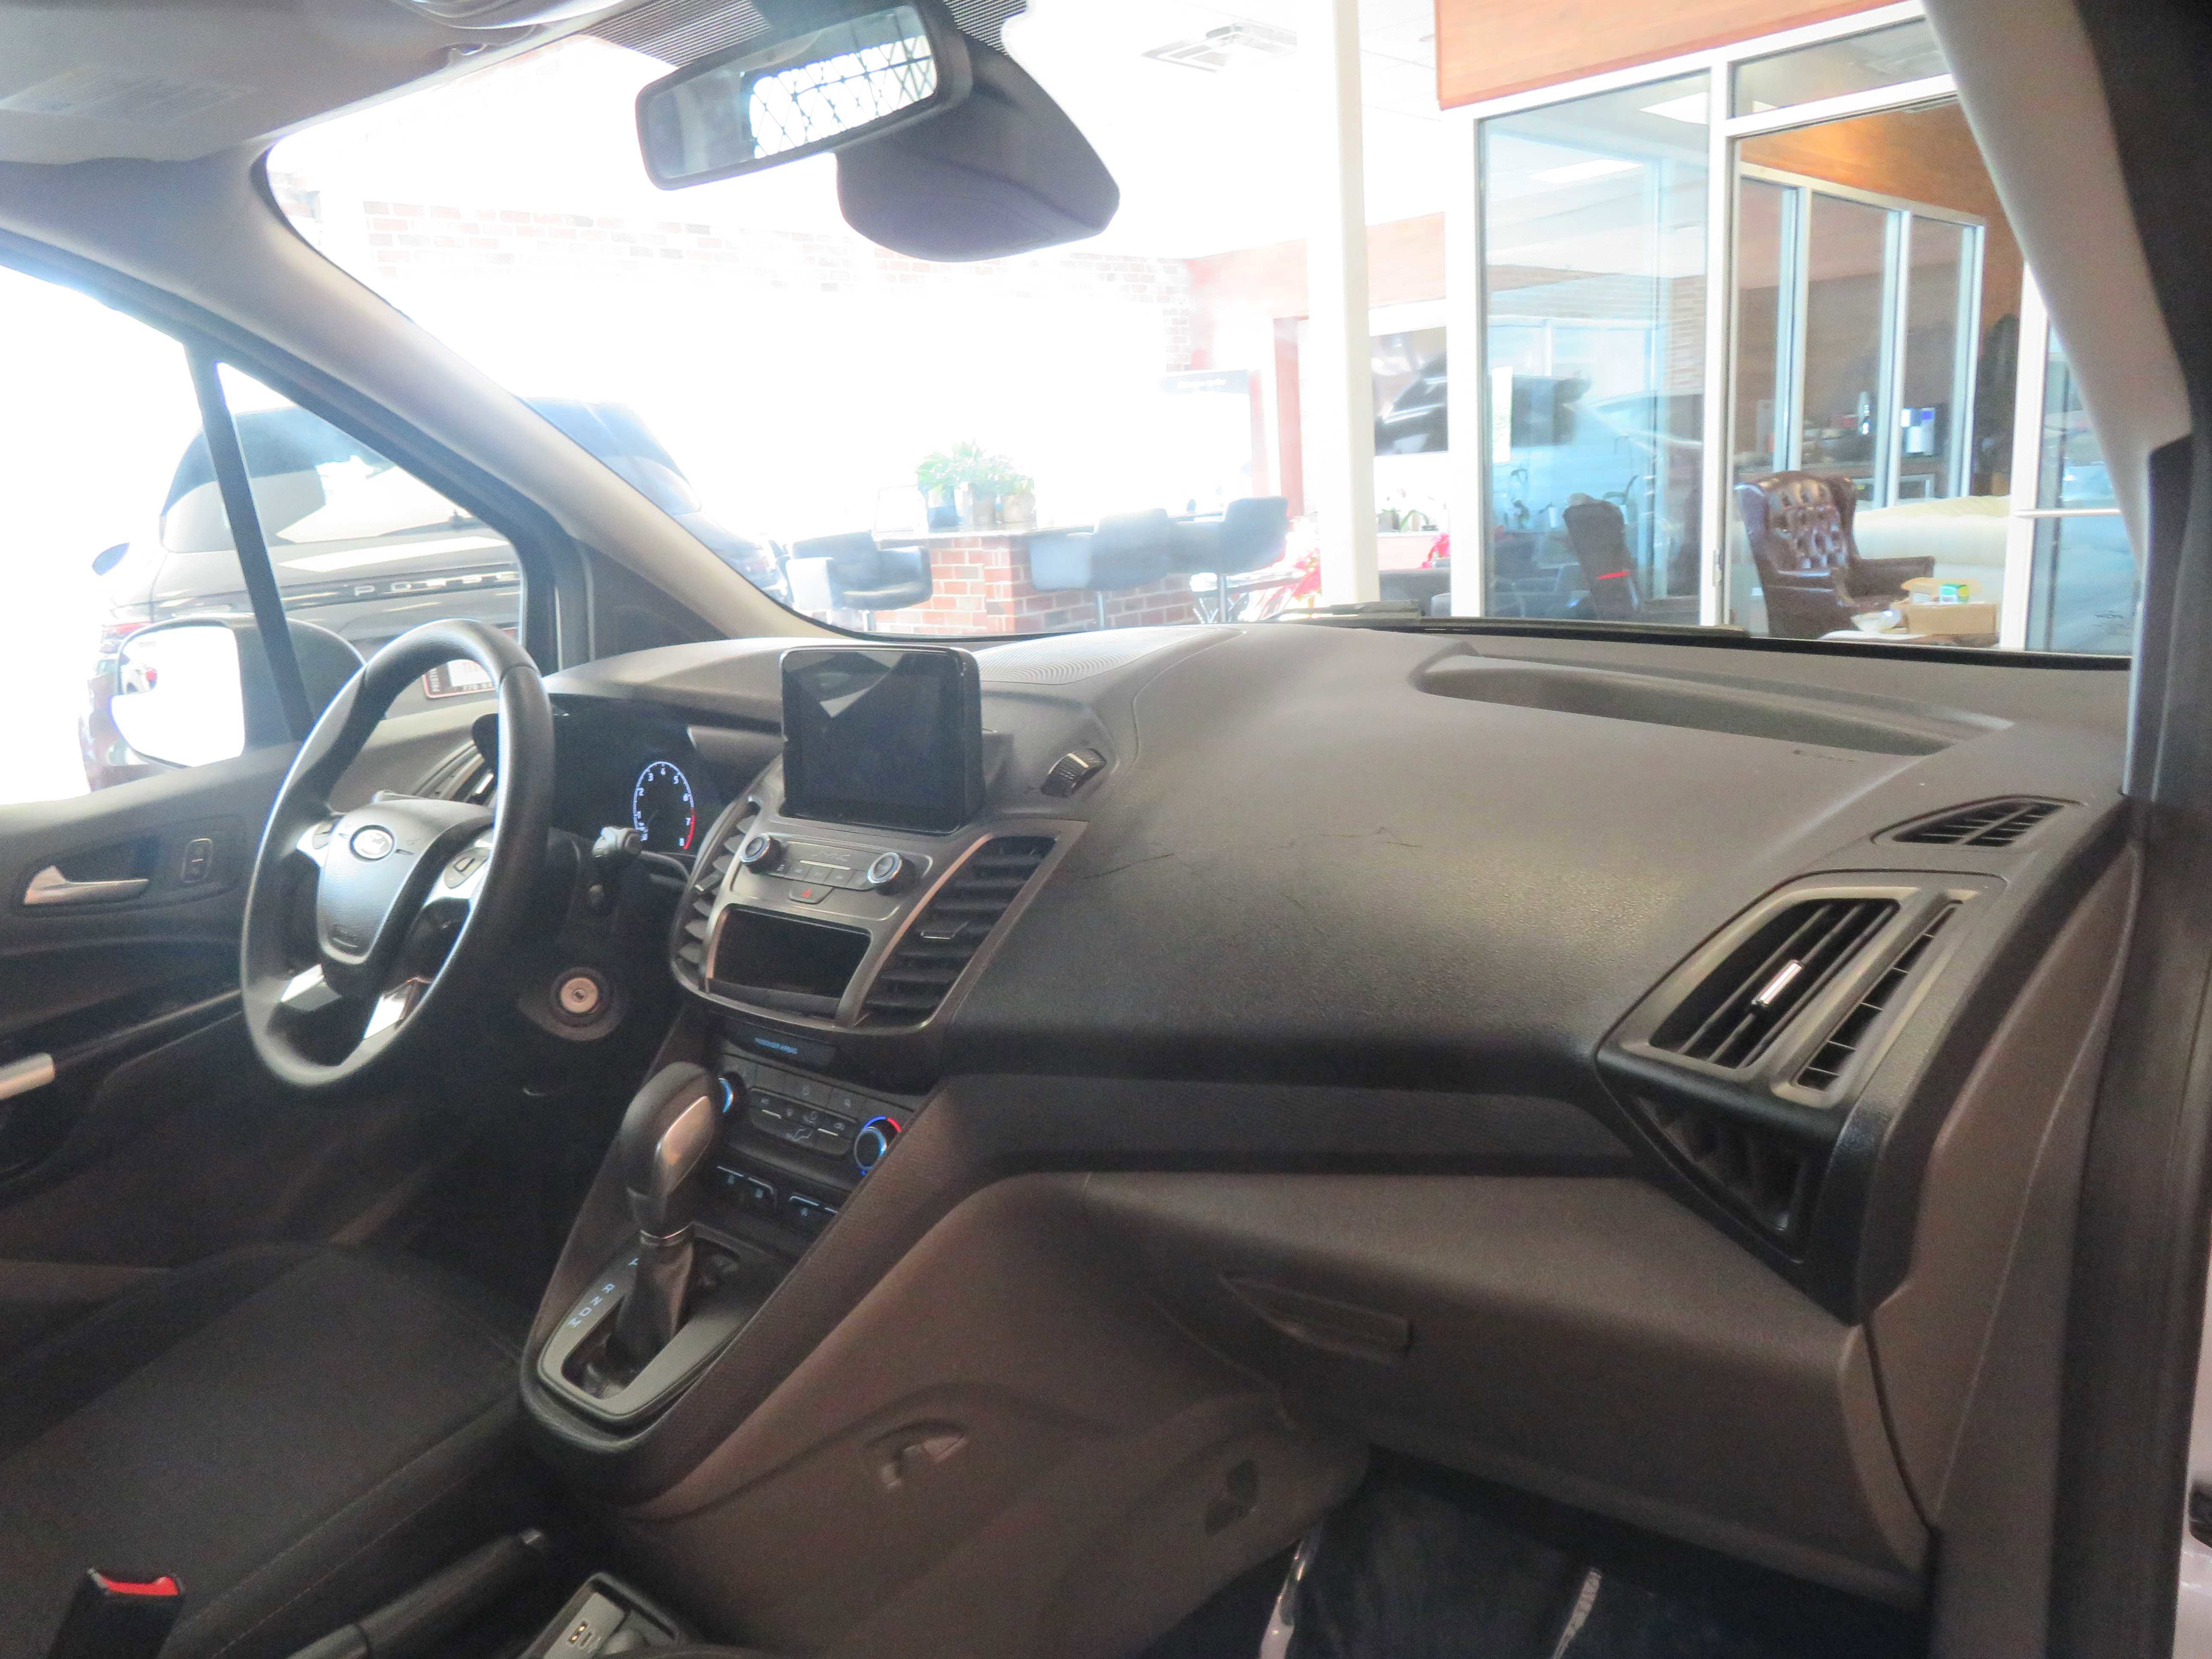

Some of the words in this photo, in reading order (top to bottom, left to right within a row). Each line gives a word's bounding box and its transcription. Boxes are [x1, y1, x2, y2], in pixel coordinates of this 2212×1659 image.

[648, 773, 654, 782] 3
[673, 776, 679, 784] 5
[638, 788, 644, 796] 2
[683, 793, 689, 801] 6
[685, 818, 691, 826] 7
[601, 1283, 615, 1294] R
[590, 1296, 603, 1306] N
